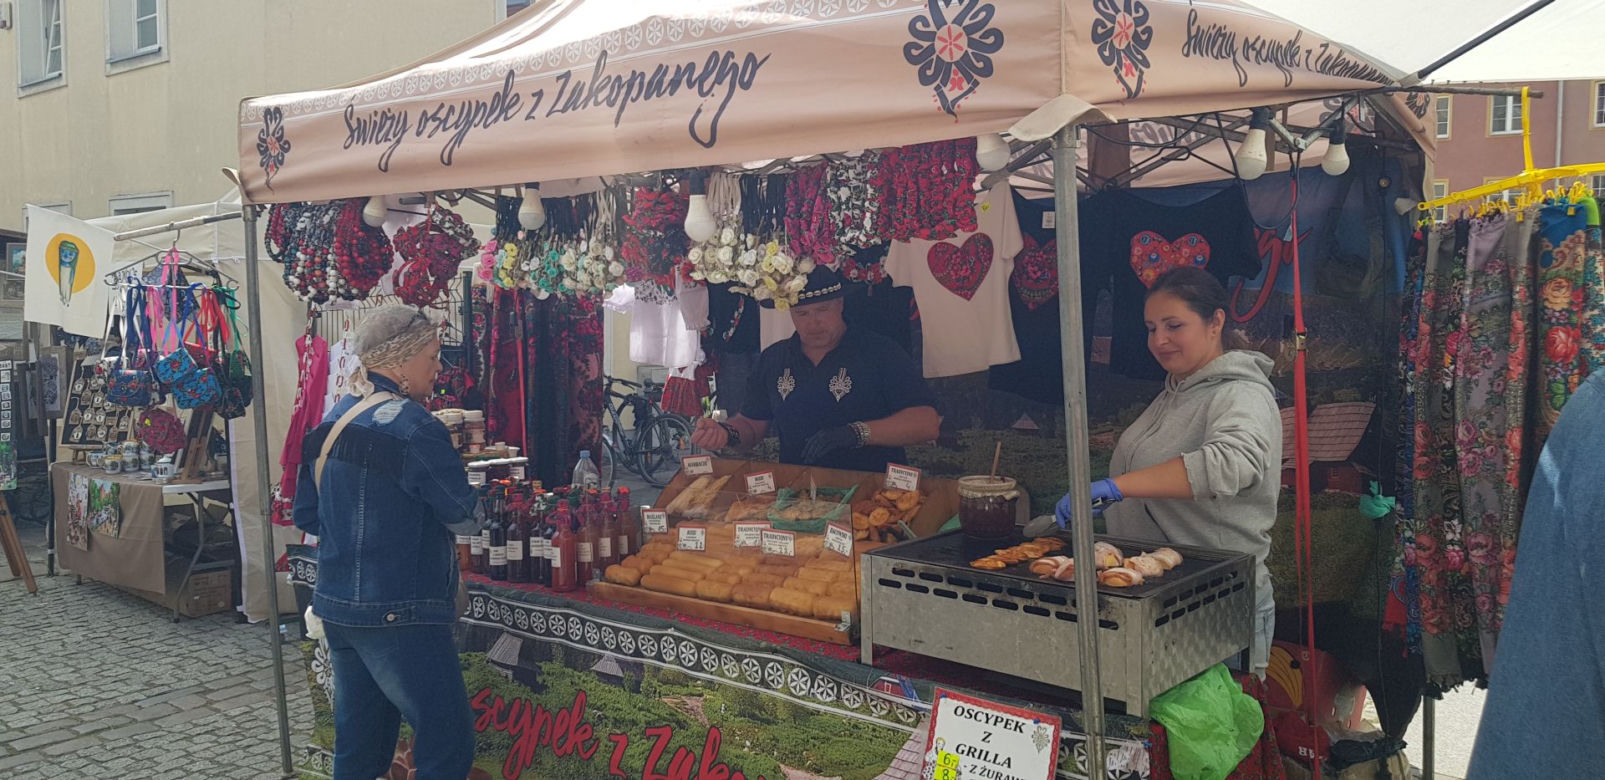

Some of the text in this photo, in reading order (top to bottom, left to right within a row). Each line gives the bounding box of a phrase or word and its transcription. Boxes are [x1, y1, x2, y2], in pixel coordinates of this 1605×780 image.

[343, 50, 772, 173] Świeży oscypek z Zakopanego
[954, 705, 1026, 733] OSCYPEK
[470, 687, 600, 780] scypek
[608, 733, 630, 780] z
[981, 731, 992, 743] Z
[955, 743, 1012, 768] GRILLA
[969, 764, 978, 774] Z
